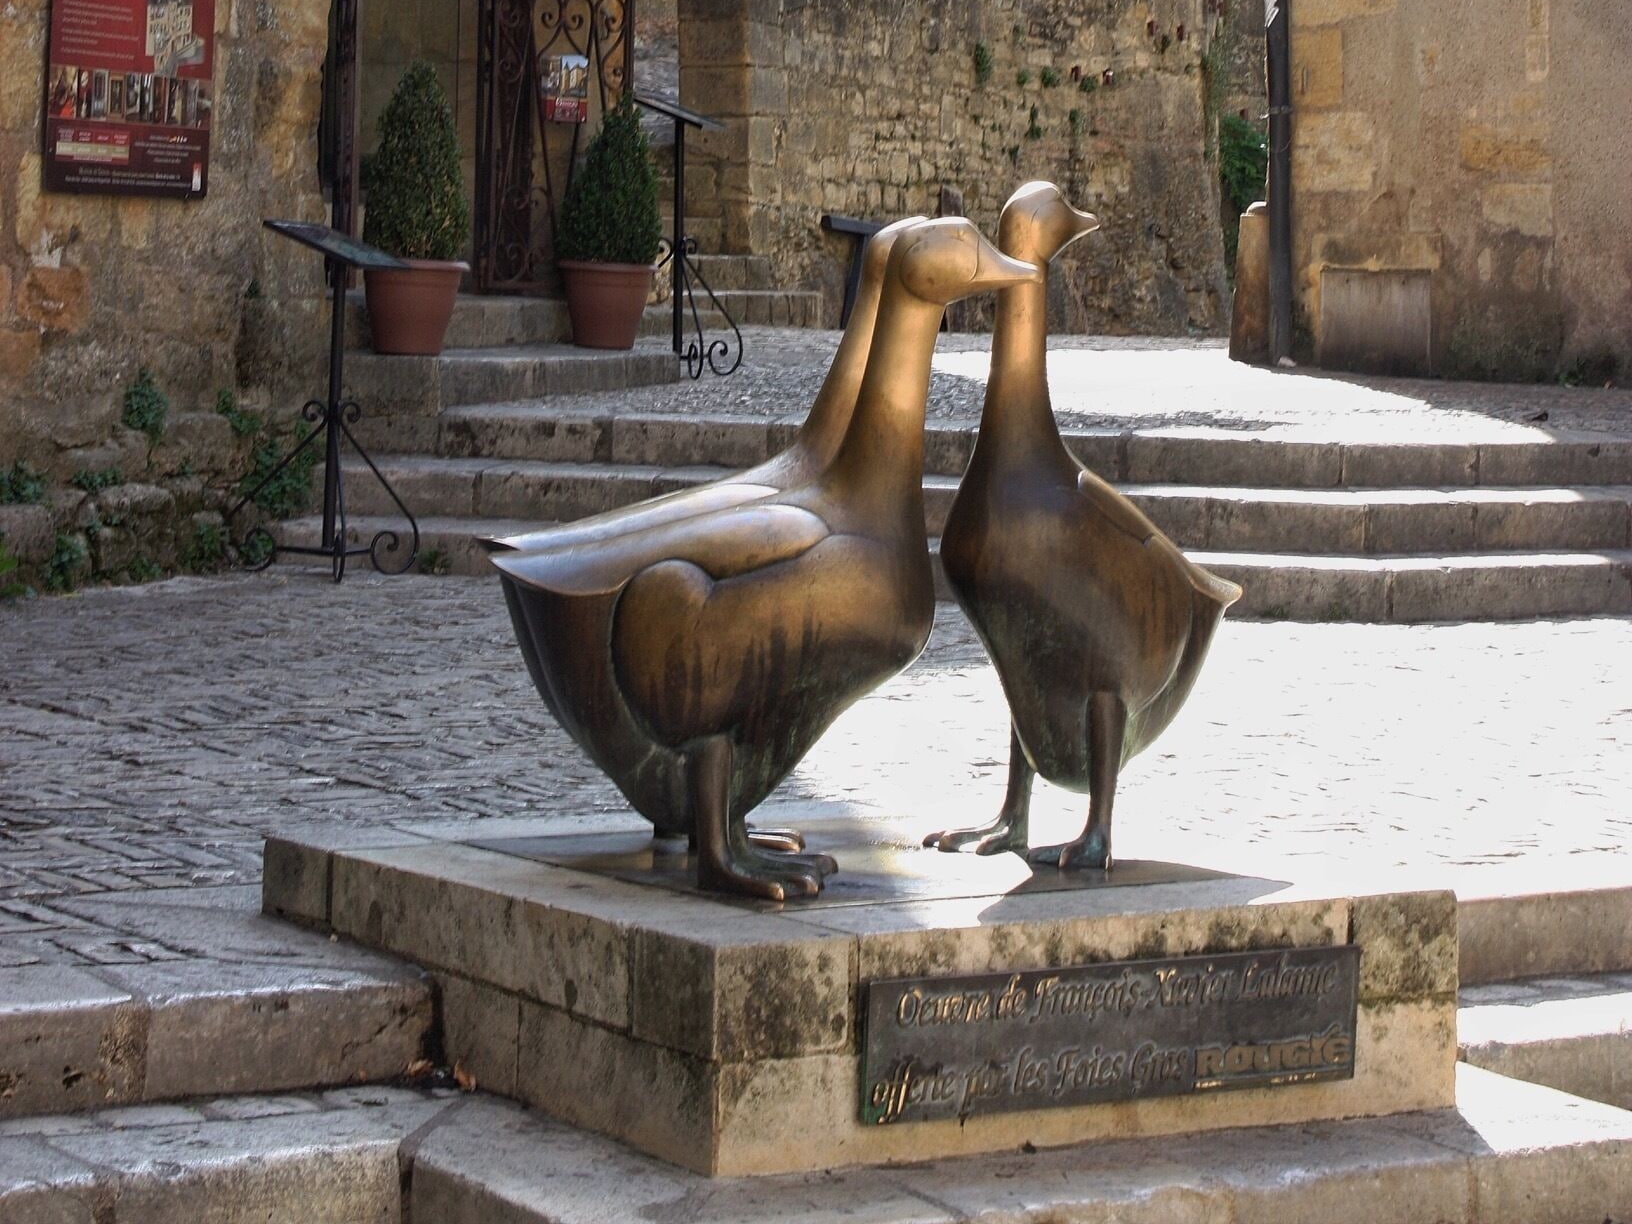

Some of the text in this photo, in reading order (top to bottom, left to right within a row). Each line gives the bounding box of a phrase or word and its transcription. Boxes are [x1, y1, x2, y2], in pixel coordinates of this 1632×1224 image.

[995, 973, 1027, 1019] de
[872, 1058, 955, 1124] offerte
[1011, 1045, 1050, 1096] les
[1050, 1045, 1125, 1097] Foies
[1129, 1041, 1189, 1096] Gras
